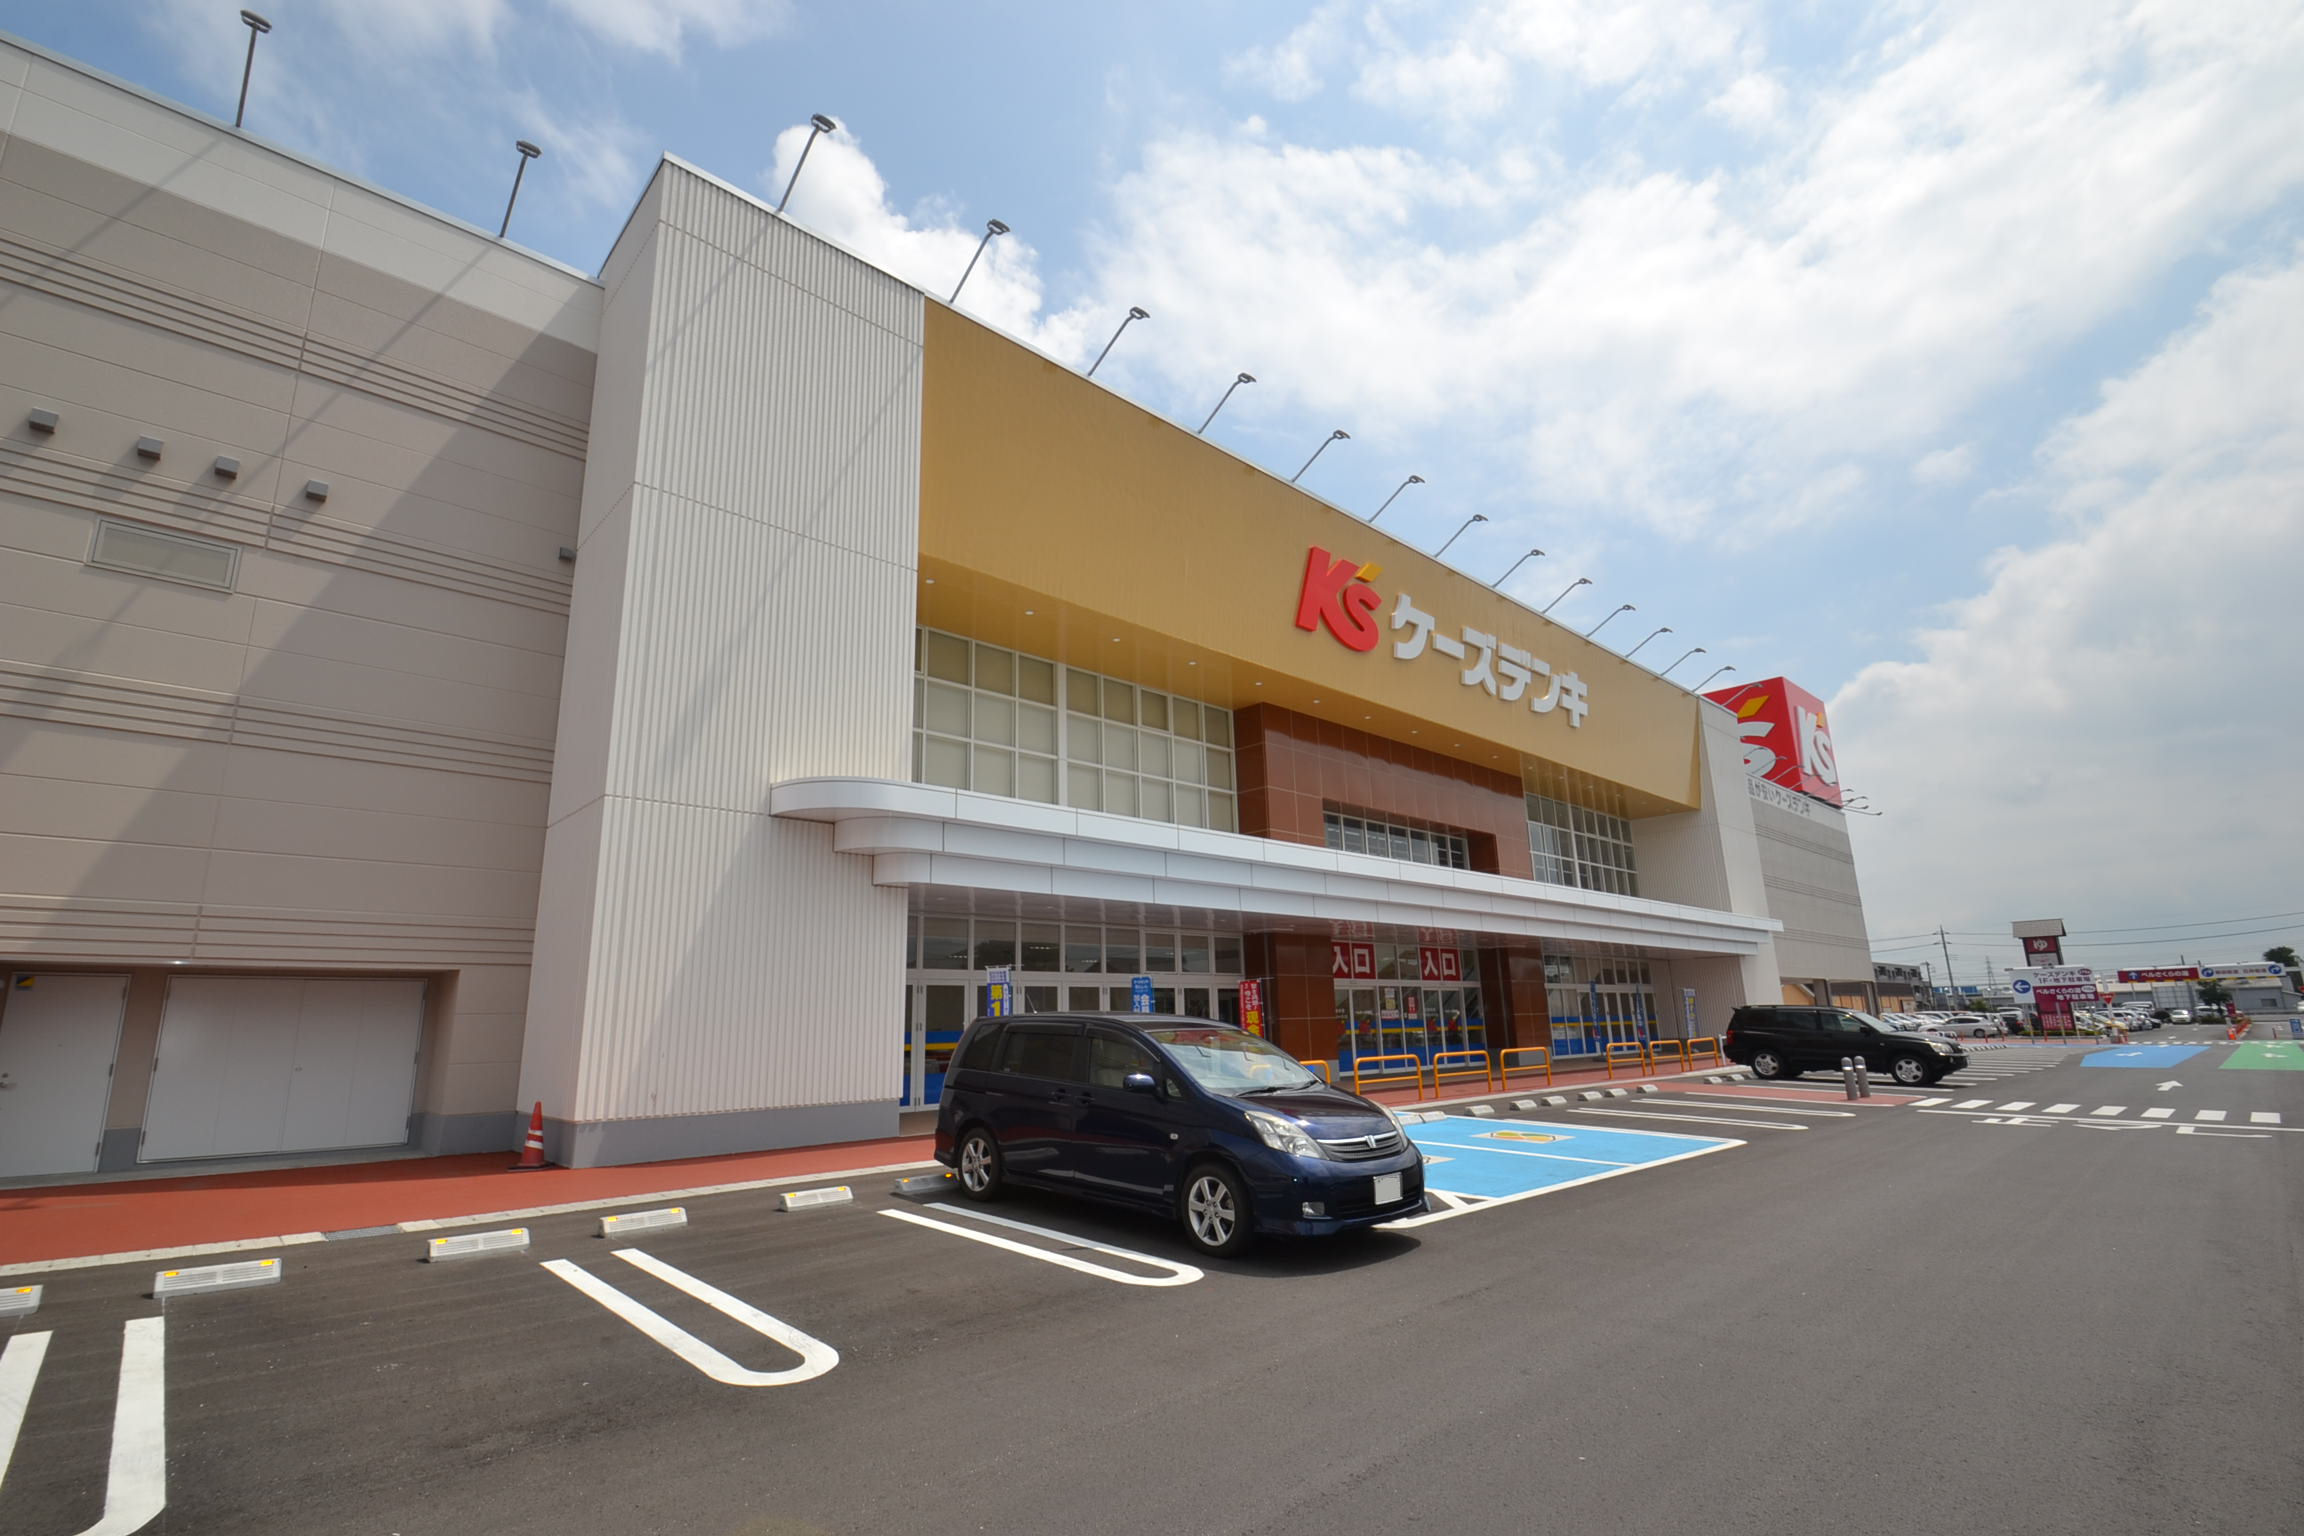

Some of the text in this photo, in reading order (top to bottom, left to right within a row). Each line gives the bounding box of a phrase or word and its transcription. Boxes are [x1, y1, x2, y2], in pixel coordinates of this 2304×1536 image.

[1391, 592, 1590, 729] ケーズデンキ
[1332, 946, 1371, 974] 入口
[1424, 951, 1457, 977] 入口
